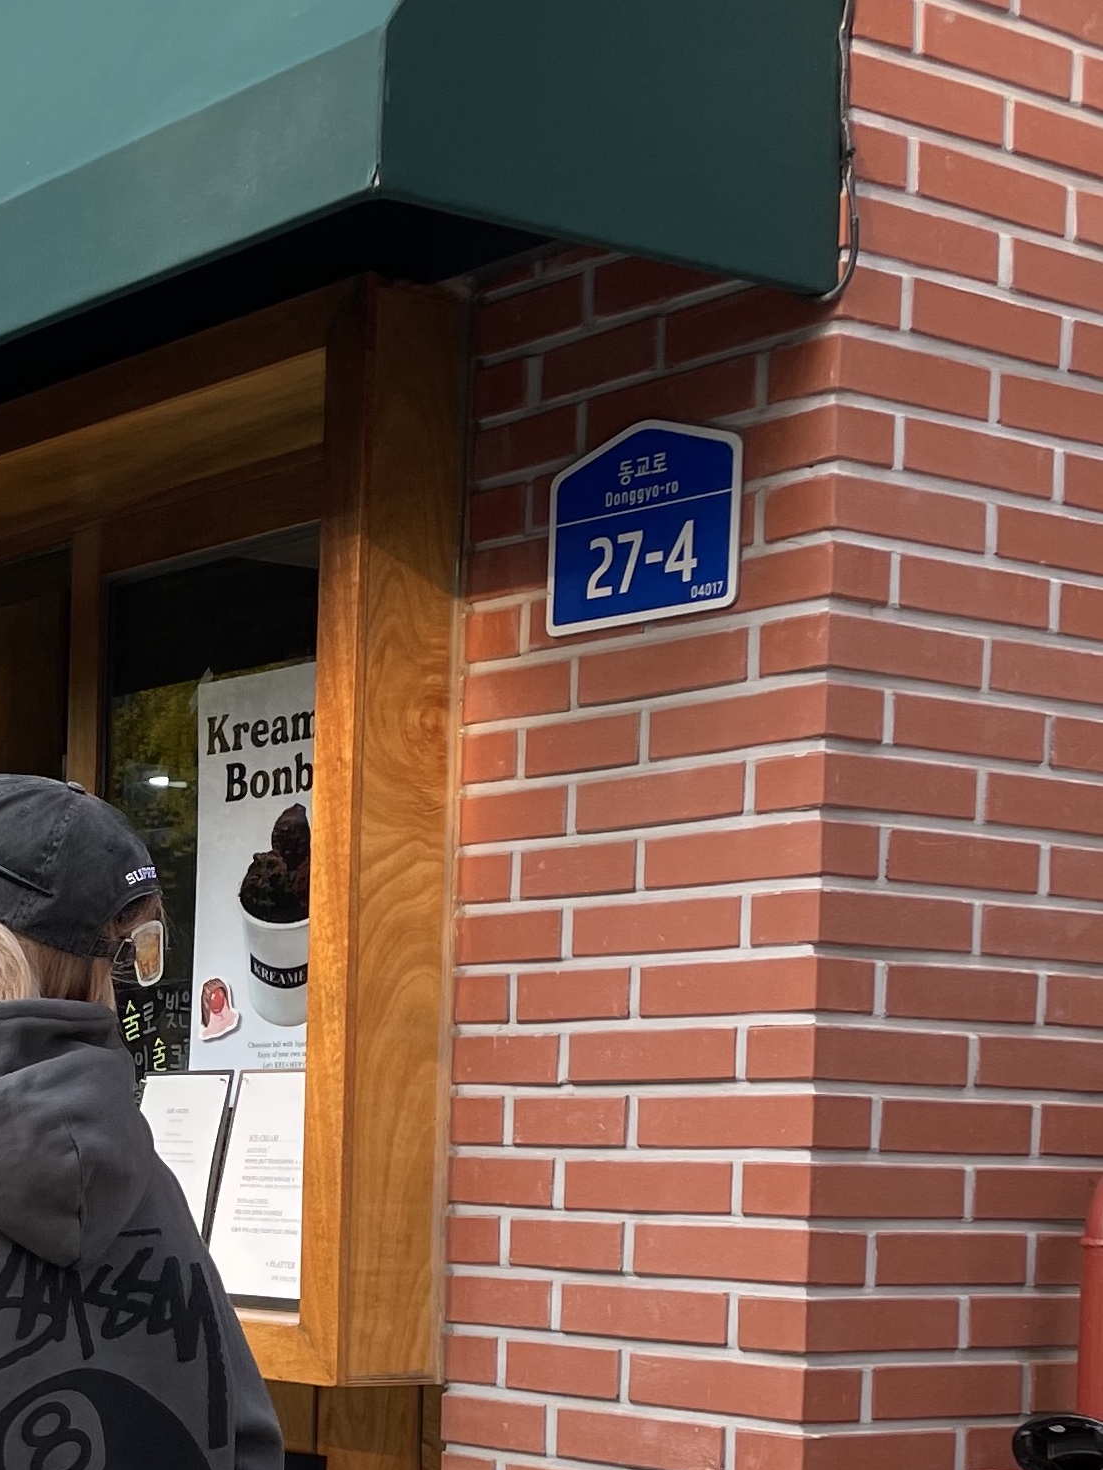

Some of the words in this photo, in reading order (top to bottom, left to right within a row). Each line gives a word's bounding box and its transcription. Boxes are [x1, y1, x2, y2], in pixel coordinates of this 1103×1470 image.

[617, 451, 669, 486] 동교로
[604, 480, 680, 508] Donggyo-ro
[586, 519, 698, 600] 27-4
[690, 580, 725, 600] 04017
